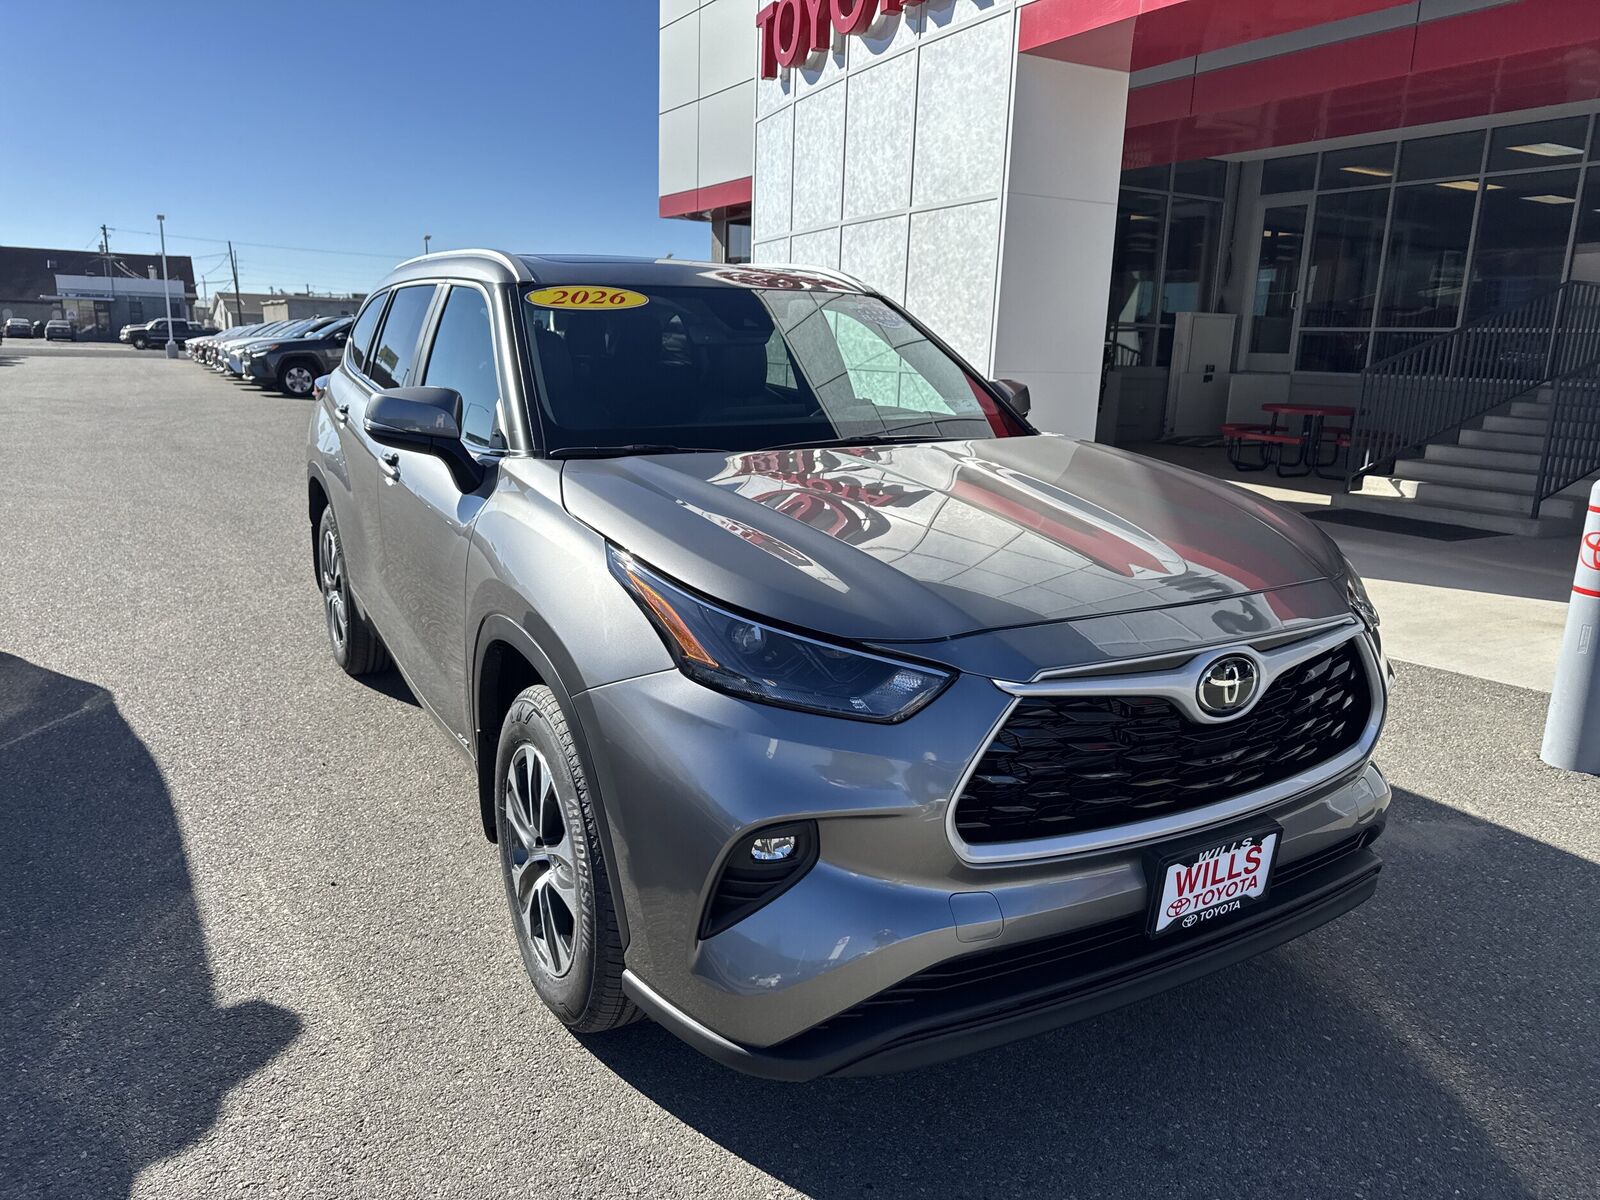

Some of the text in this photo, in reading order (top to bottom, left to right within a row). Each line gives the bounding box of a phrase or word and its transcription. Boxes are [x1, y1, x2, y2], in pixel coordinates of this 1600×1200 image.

[756, 0, 927, 81] TOYO
[550, 290, 628, 305] 2026
[1199, 837, 1252, 862] WILLS
[1176, 845, 1262, 897] WILLS
[1193, 875, 1258, 909] TOYOTA
[1200, 900, 1241, 921] TOYOTA
